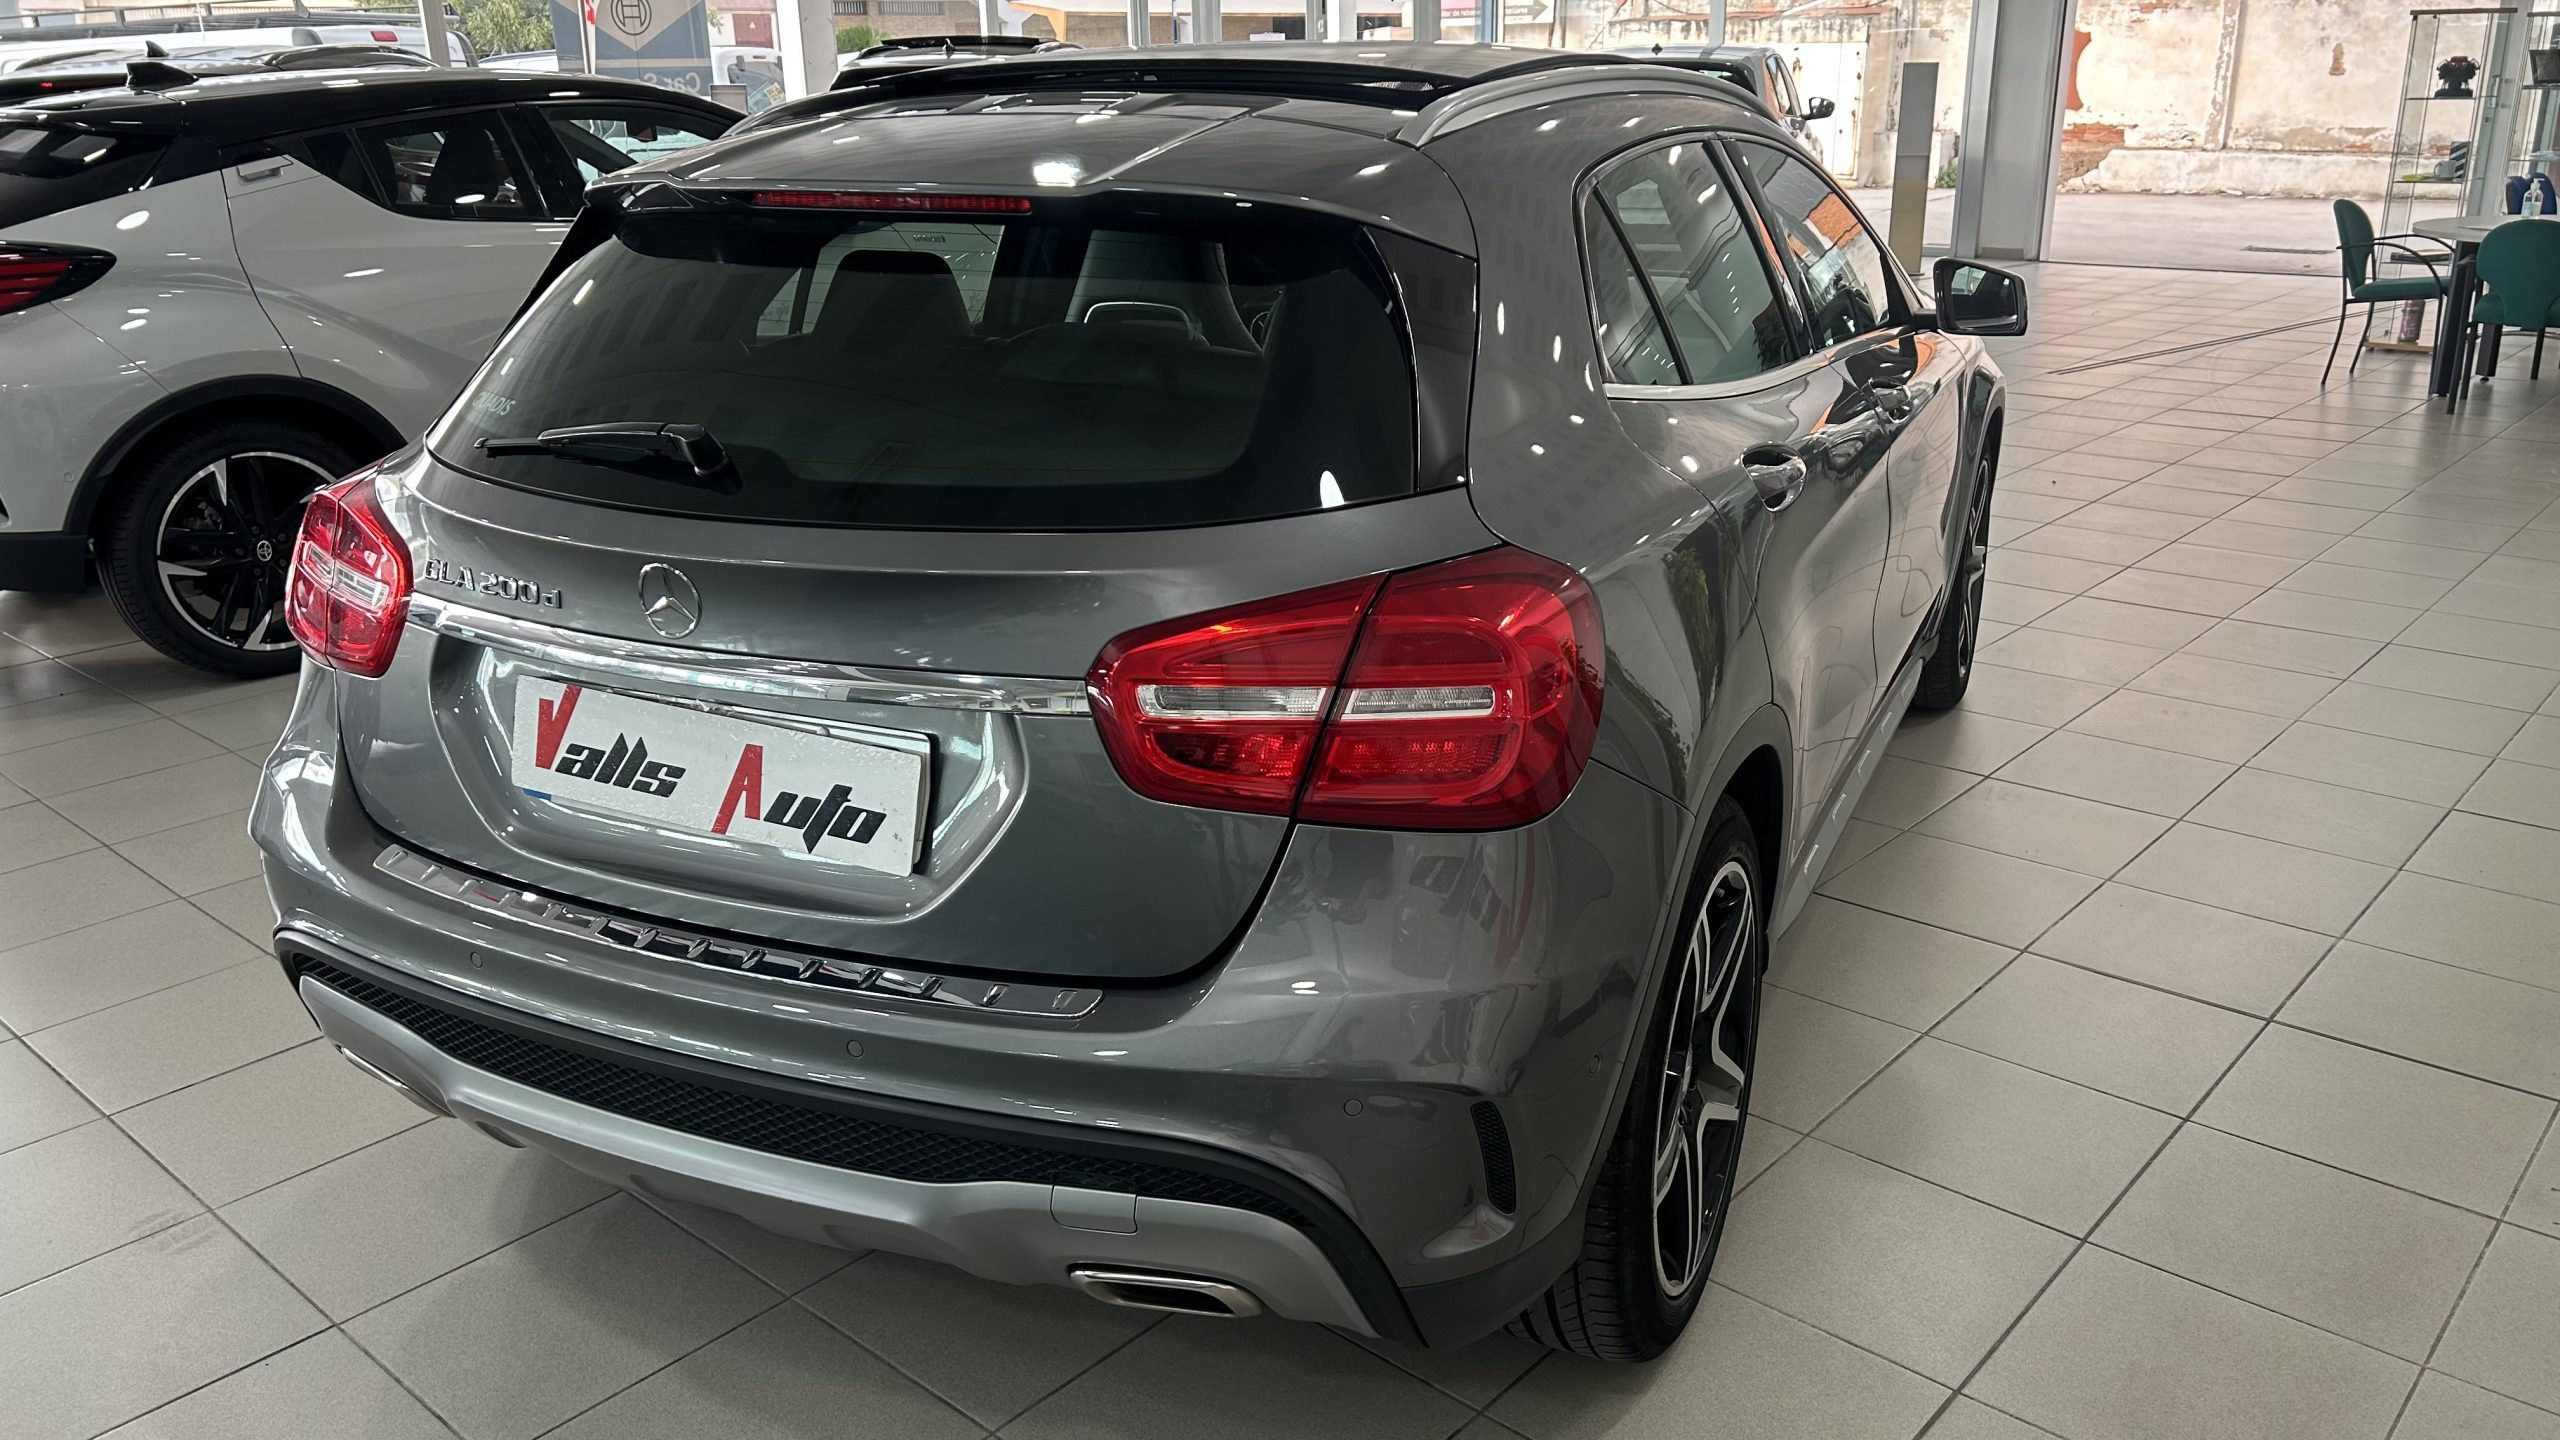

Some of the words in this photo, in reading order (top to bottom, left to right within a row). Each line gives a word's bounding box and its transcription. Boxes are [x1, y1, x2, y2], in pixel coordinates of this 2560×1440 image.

[424, 558, 475, 591] GLA
[535, 684, 686, 799] Valls
[711, 744, 887, 854] Auto
